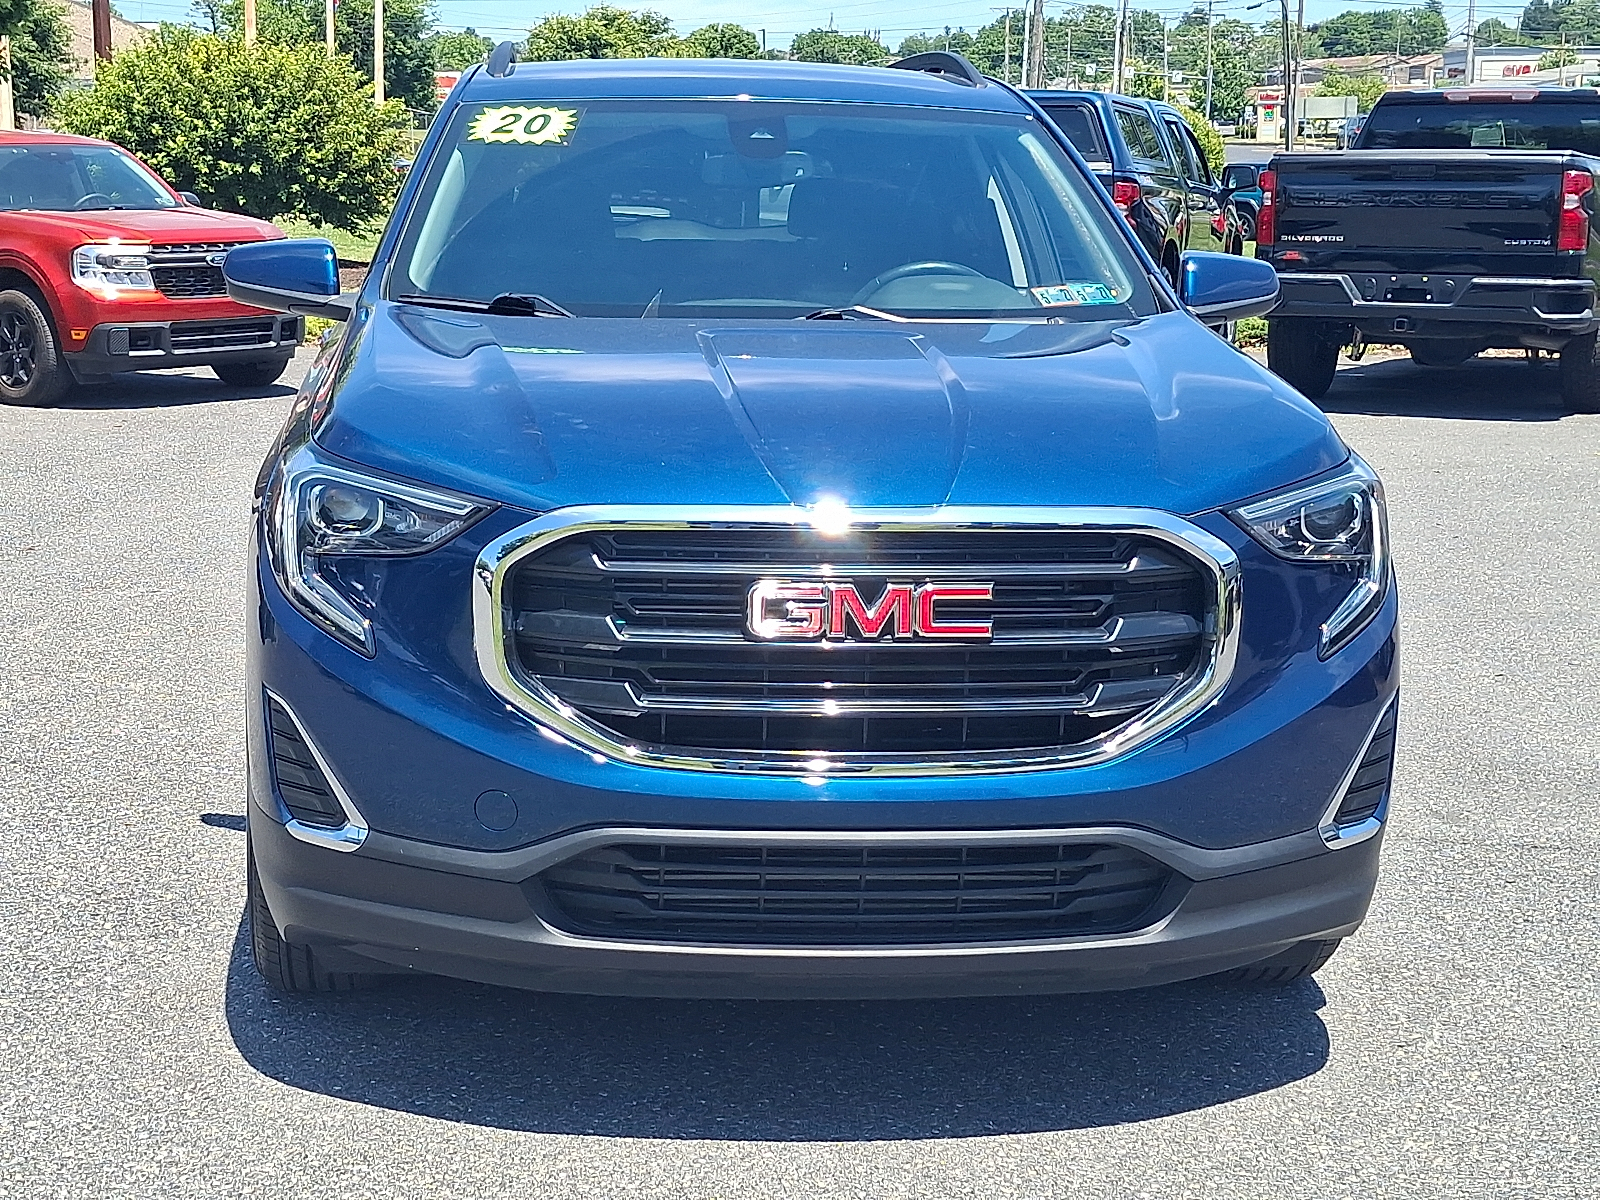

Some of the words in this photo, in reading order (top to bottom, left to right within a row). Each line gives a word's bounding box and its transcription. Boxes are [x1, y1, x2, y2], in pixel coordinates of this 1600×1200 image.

[490, 113, 552, 135] 20
[1280, 235, 1344, 243] SILVERADO
[1040, 293, 1051, 304] 5
[1076, 290, 1087, 301] 5
[747, 579, 993, 637] GMC
